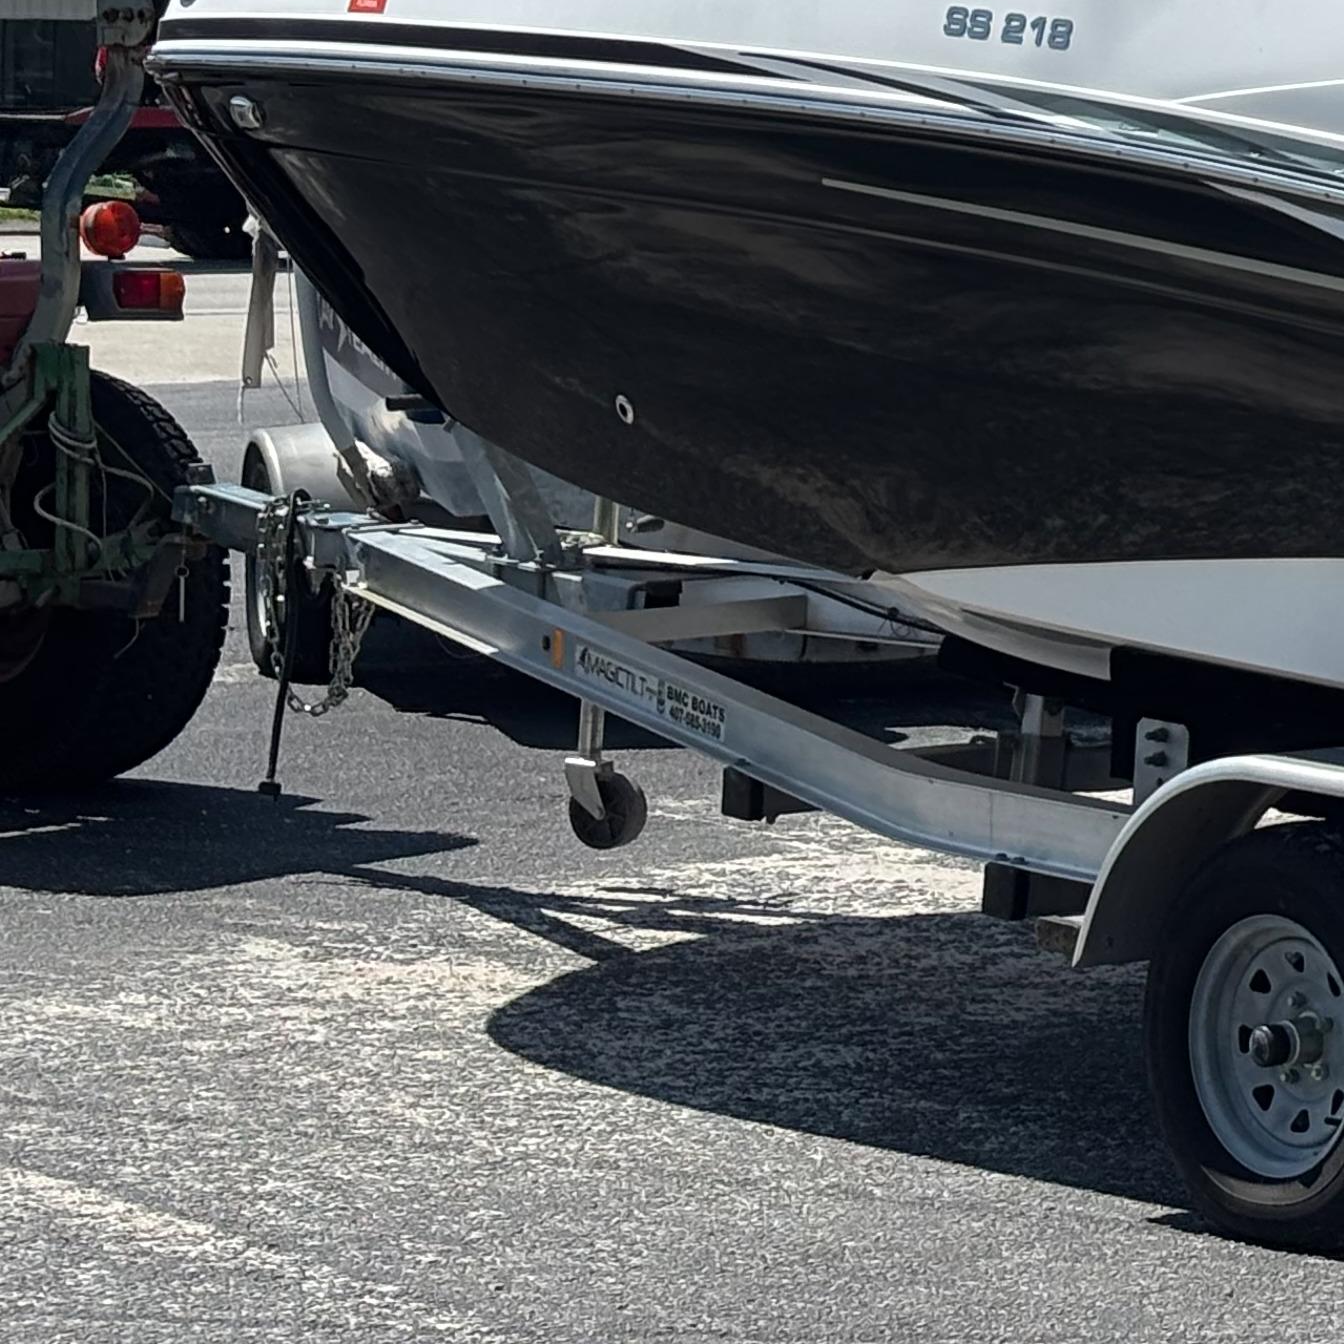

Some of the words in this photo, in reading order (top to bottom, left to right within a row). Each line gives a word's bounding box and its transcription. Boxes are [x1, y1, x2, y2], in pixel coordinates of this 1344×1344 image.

[943, 6, 993, 41] SS
[1001, 12, 1074, 51] 218
[667, 685, 689, 708] BMC
[691, 695, 725, 723] BOATS
